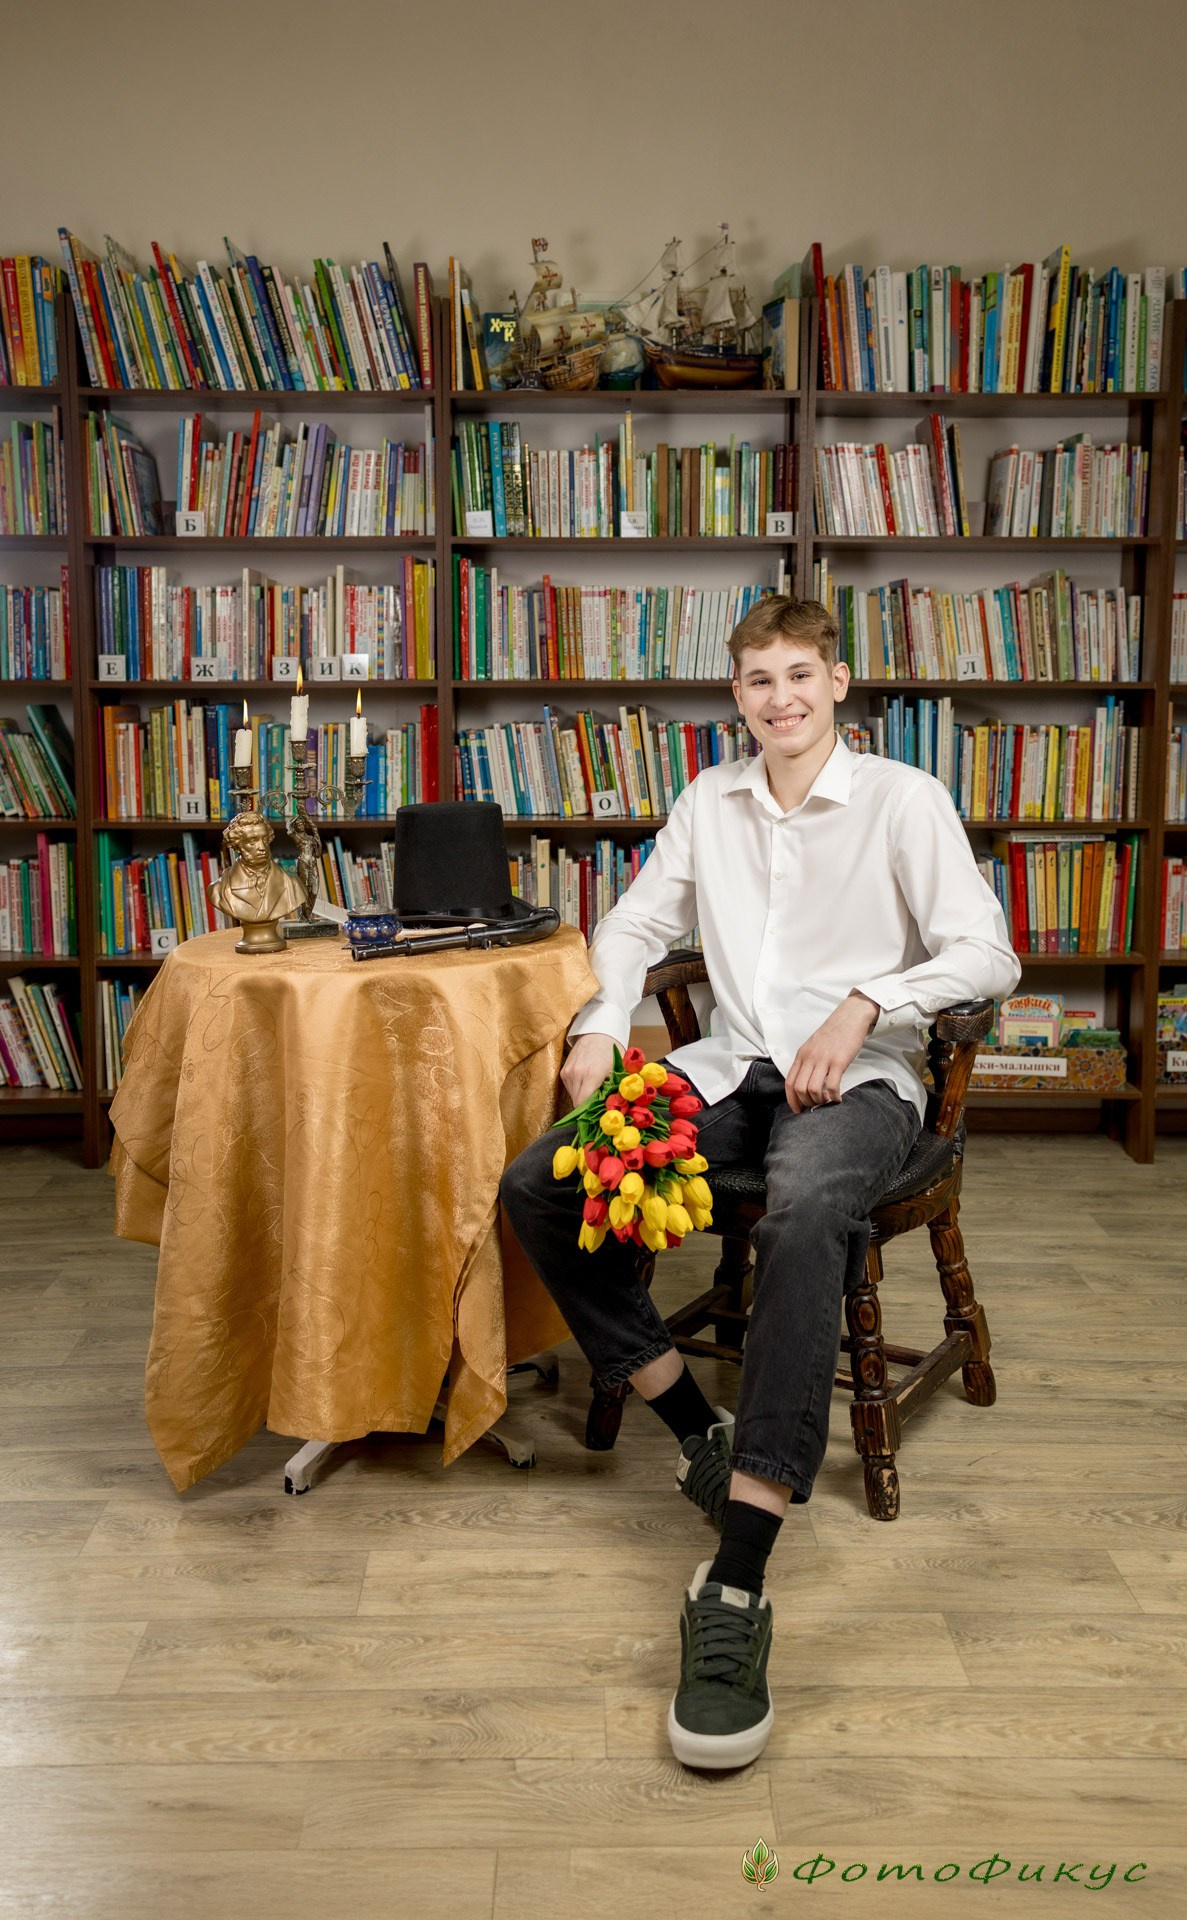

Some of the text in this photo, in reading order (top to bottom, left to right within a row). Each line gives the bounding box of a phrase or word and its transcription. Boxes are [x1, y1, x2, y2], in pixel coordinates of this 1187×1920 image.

[18, 259, 28, 287] ШКОЛЫ
[21, 290, 32, 332] НАЧАЛЬНОЙ
[1150, 338, 1159, 360] ВСЕ
[1149, 364, 1157, 391] ХОЧУ
[184, 519, 196, 532] Б
[773, 520, 786, 533] В
[106, 662, 118, 675] Е
[195, 664, 214, 677] Ж
[279, 663, 290, 676] З
[319, 663, 334, 675] И
[349, 662, 362, 675] К
[963, 660, 976, 675] Л
[186, 801, 199, 814] Н
[598, 797, 611, 810] О
[157, 935, 169, 949] С
